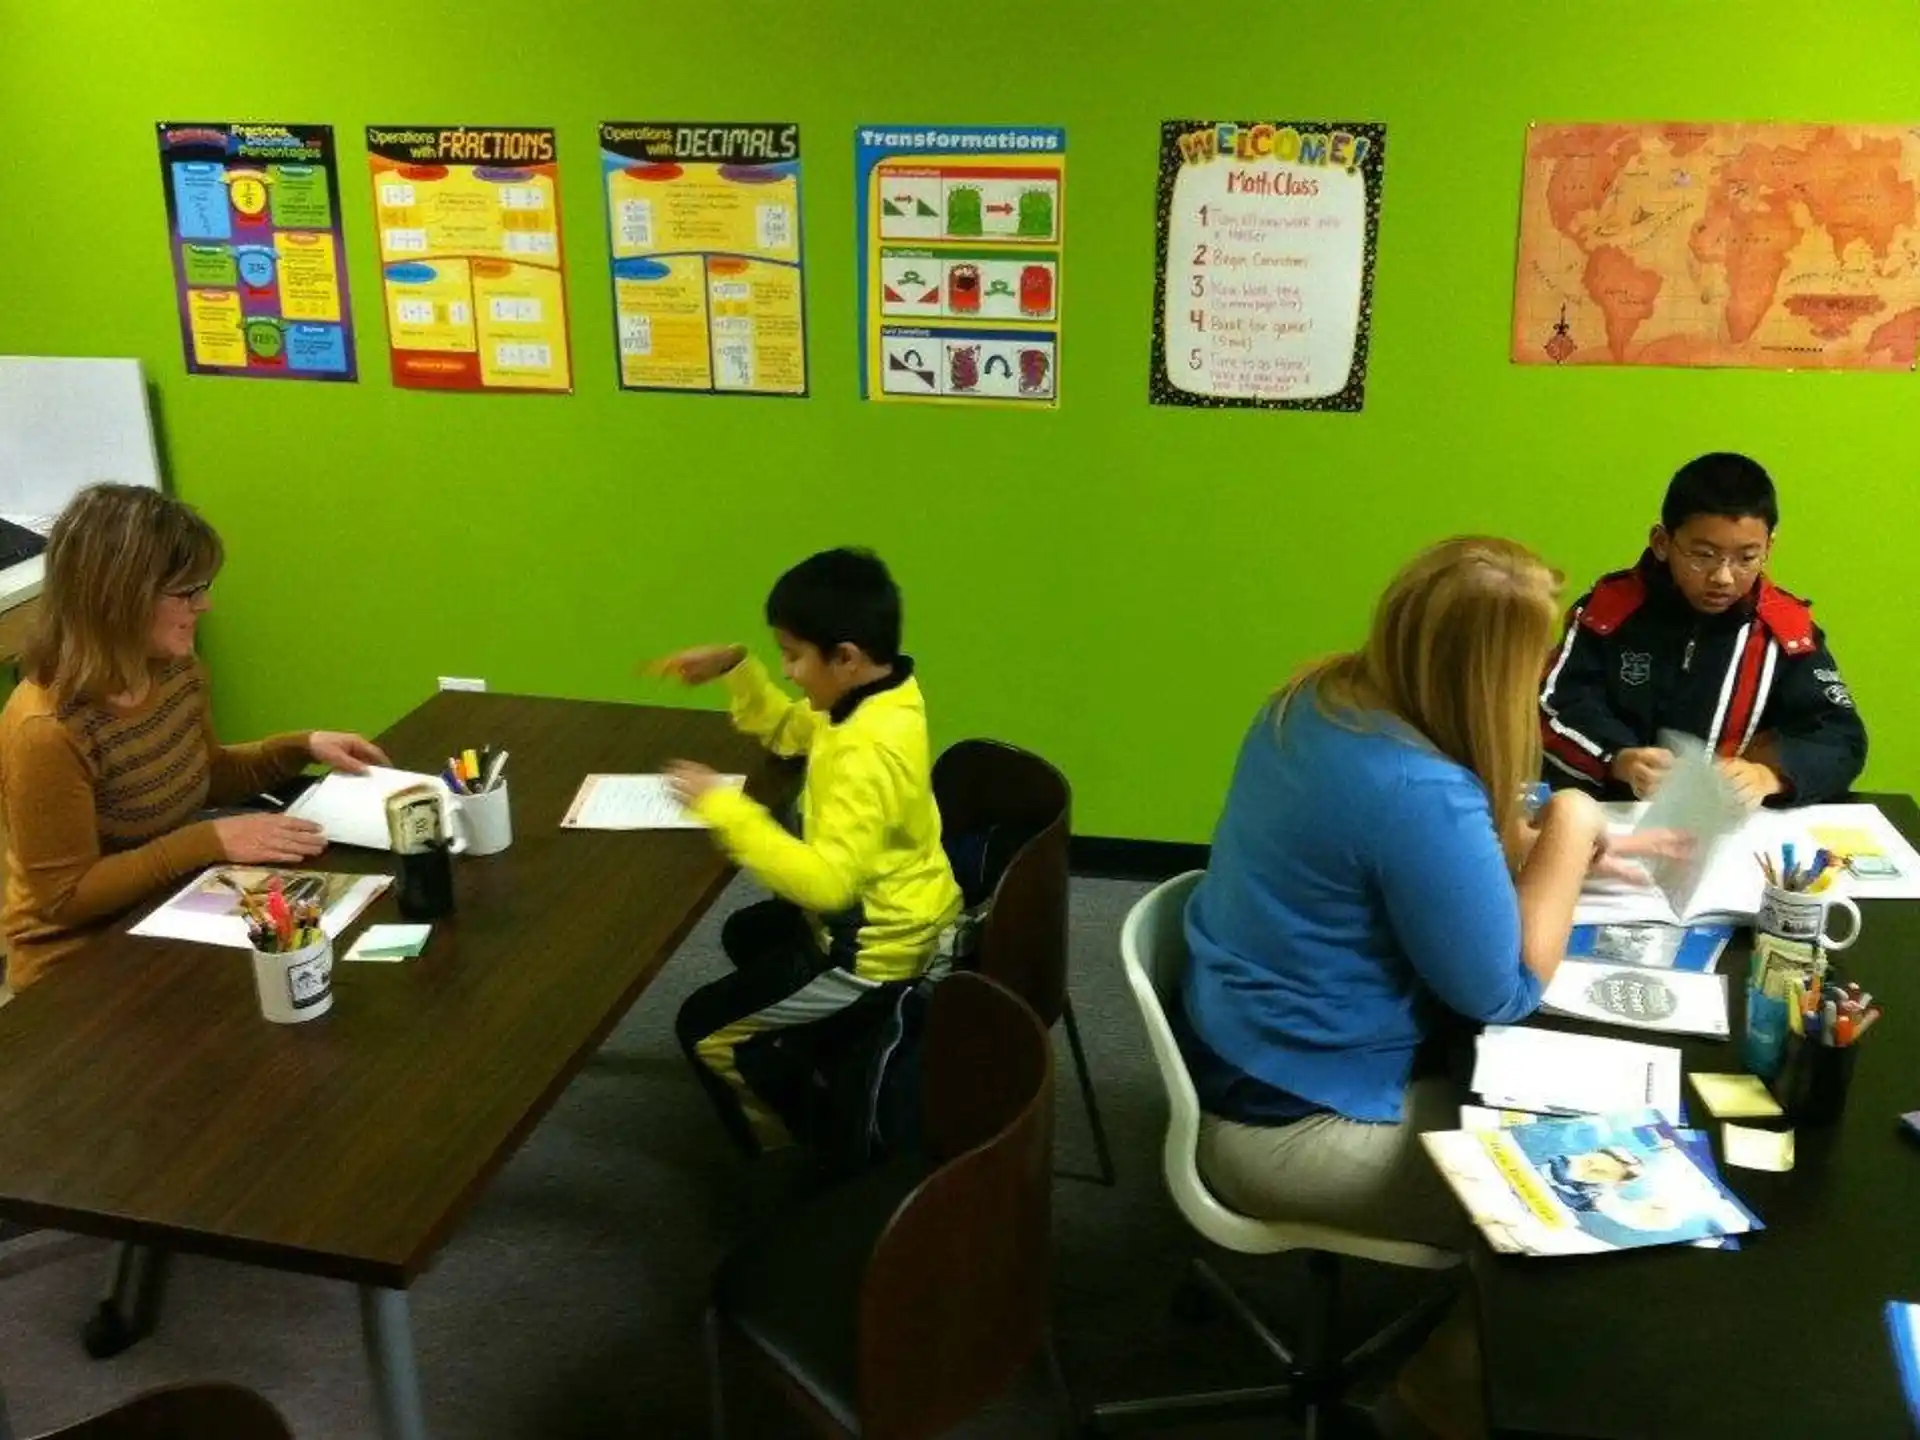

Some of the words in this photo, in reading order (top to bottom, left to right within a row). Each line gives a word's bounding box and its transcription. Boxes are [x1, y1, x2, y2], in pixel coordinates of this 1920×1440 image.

[369, 128, 436, 147] Operations
[410, 145, 438, 159] with
[438, 131, 553, 160] FRACTIONS
[603, 126, 673, 142] Operations
[646, 141, 674, 156] with
[675, 127, 797, 158] DECIMALS
[861, 129, 1059, 150] Transformations
[1179, 124, 1371, 176] WELCOME!
[1227, 170, 1272, 196] Math
[1273, 171, 1319, 197] Class
[1198, 204, 1208, 227] 1
[1193, 244, 1207, 266] 2
[1191, 275, 1205, 297] 3
[1190, 309, 1206, 333] 4
[1188, 347, 1203, 371] 5
